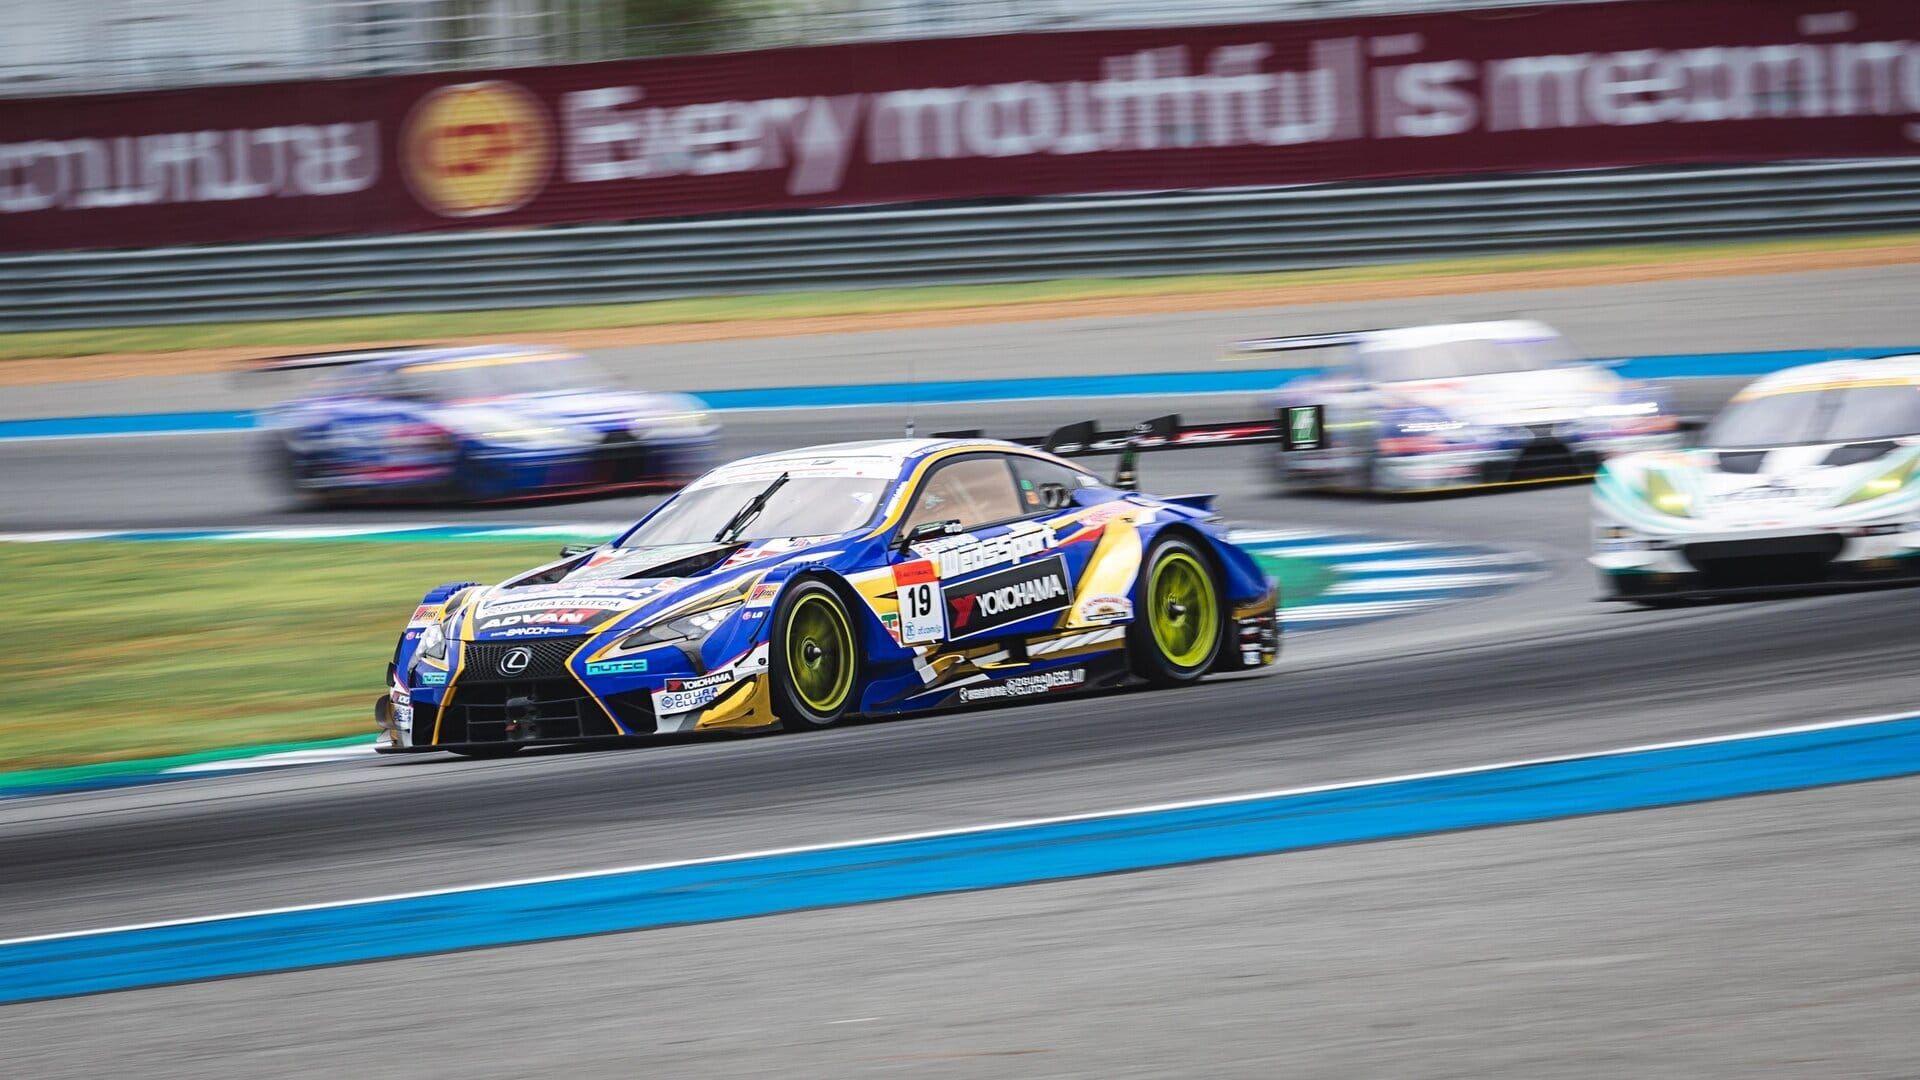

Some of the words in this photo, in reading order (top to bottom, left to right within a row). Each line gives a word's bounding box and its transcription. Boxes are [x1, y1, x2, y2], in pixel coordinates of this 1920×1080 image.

[560, 86, 861, 196] Every
[867, 35, 1363, 163] mouthful
[1372, 29, 1479, 139] is
[559, 600, 621, 608] CLUTCH
[908, 584, 931, 618] 19
[975, 574, 1066, 617] YOKOHAMA
[480, 613, 585, 629] ADVAN
[682, 672, 731, 690] YOKOHAMA
[675, 687, 718, 700] OGURA
[675, 695, 717, 708] CLUTC
